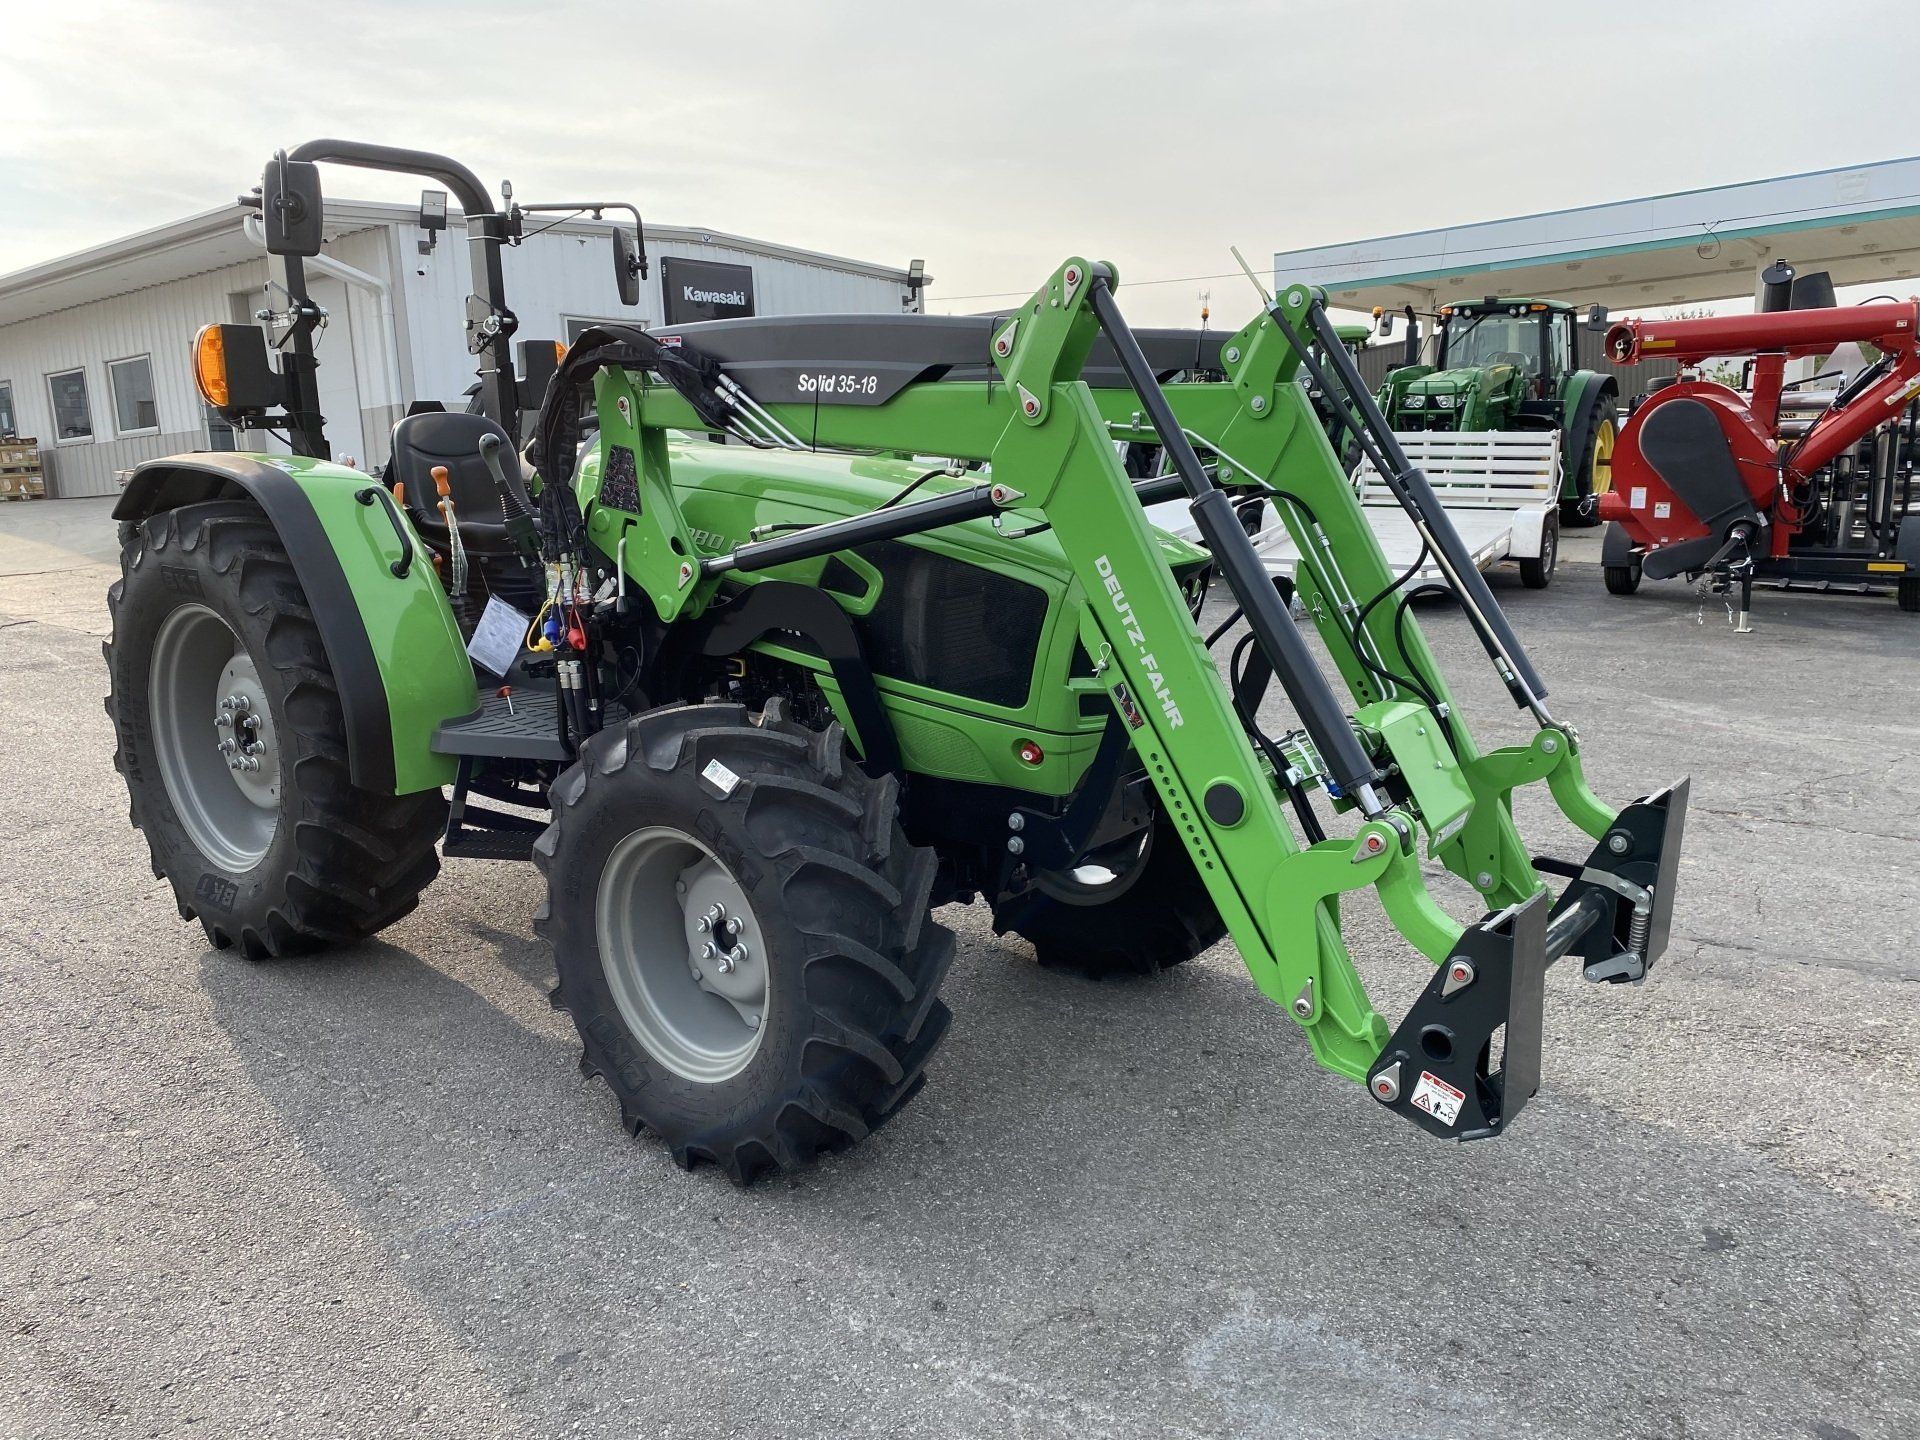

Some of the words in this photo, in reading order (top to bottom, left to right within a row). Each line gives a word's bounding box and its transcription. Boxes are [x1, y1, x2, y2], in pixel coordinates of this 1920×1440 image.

[683, 286, 745, 305] Kawasaki
[797, 373, 836, 392] Solid
[837, 375, 878, 394] 35-18
[1095, 555, 1184, 731] DEUTZ-FAHR
